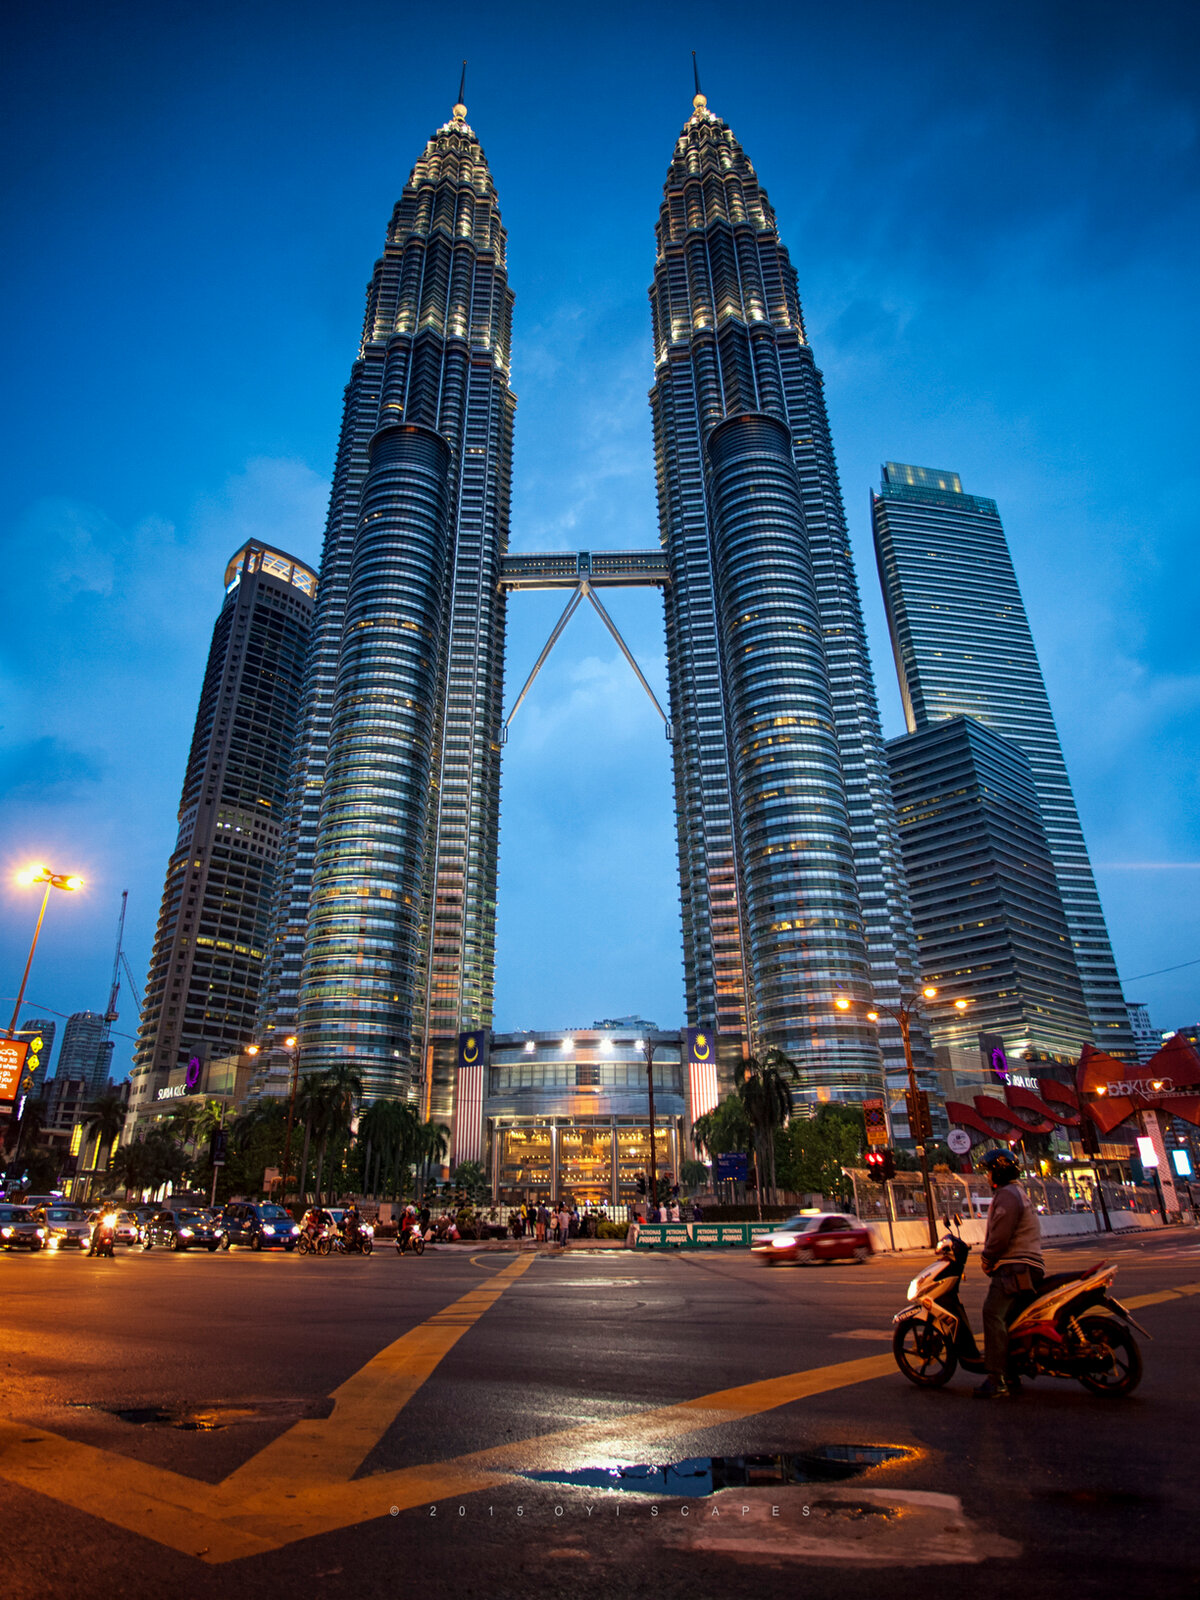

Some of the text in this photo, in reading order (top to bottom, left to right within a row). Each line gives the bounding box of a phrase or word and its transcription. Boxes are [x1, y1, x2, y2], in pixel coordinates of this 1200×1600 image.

[1005, 1073, 1026, 1088] SRIA
[1107, 1077, 1176, 1102] bbKLCC
[721, 1234, 742, 1242] PRIMAX
